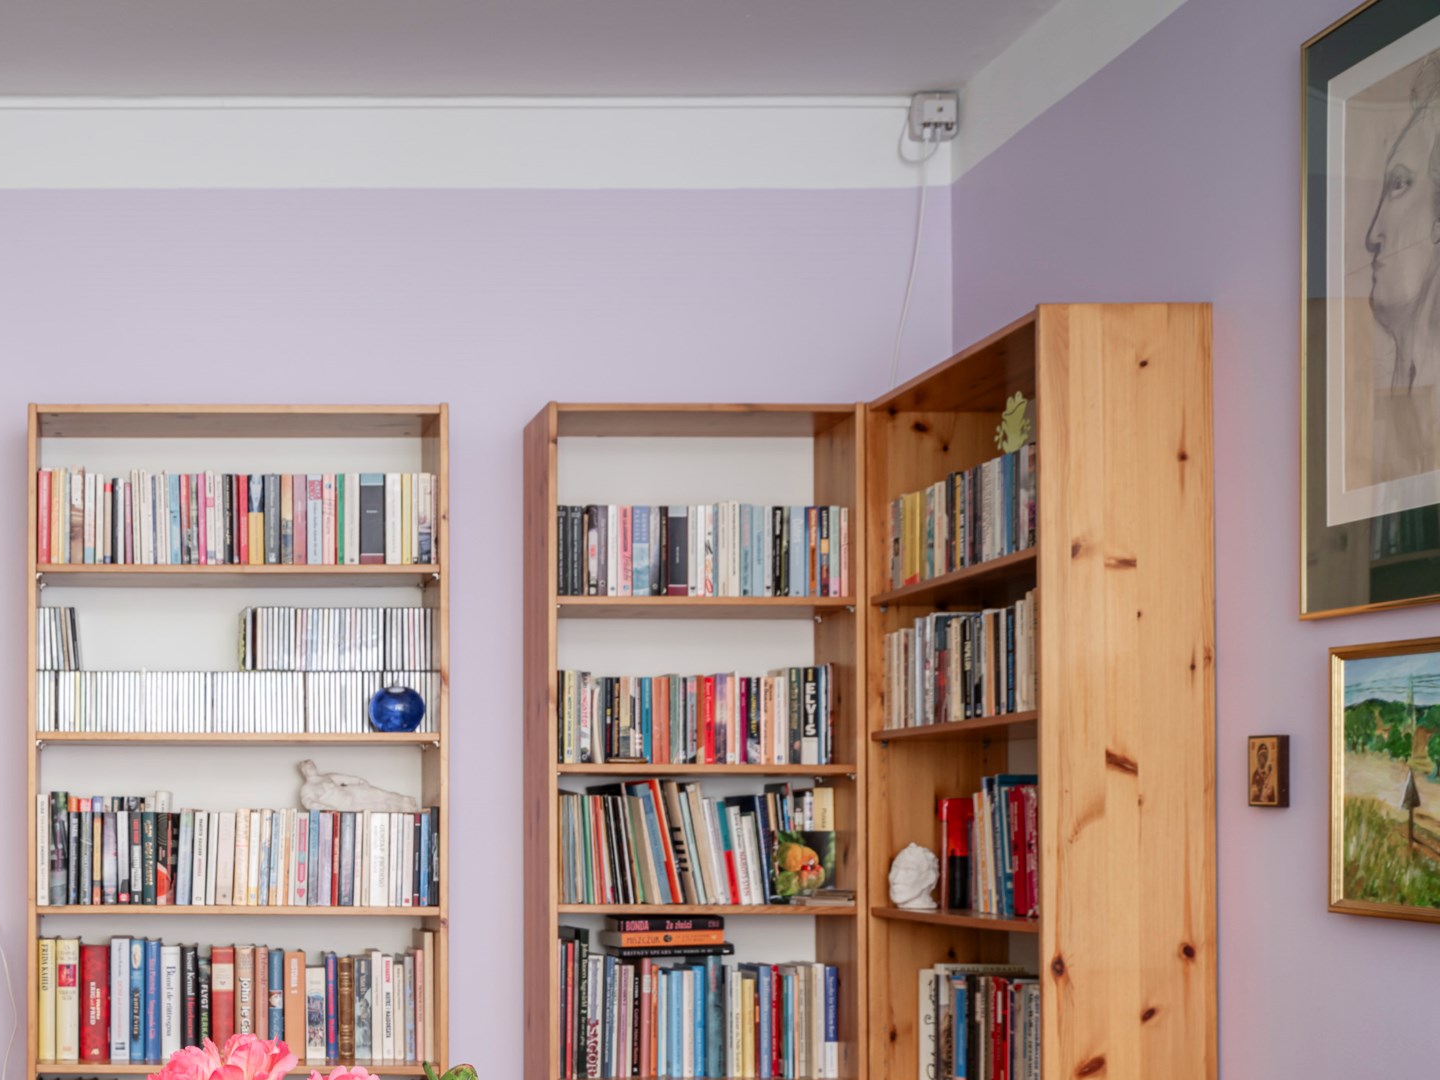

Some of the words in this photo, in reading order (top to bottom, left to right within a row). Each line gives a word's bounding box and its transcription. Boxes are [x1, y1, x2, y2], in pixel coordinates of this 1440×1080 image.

[805, 682, 817, 736] ELVIS
[378, 824, 386, 852] GUSTAF
[378, 856, 386, 888] FRÖDING
[625, 920, 650, 932] BONDA
[41, 944, 49, 965] FRIDA
[579, 943, 588, 958] John
[41, 966, 49, 991] KAHLO
[166, 966, 176, 990] Bland
[579, 959, 588, 978] Bauers
[186, 972, 195, 996] Kemal
[239, 976, 251, 1002] John
[132, 992, 140, 1013] Santa
[166, 992, 174, 1001] de
[201, 984, 209, 1009] FLYGT
[164, 1002, 174, 1036] rättrogna
[241, 1006, 251, 1016] le
[132, 1014, 140, 1034] Evita
[586, 1026, 598, 1072] SAGOR
